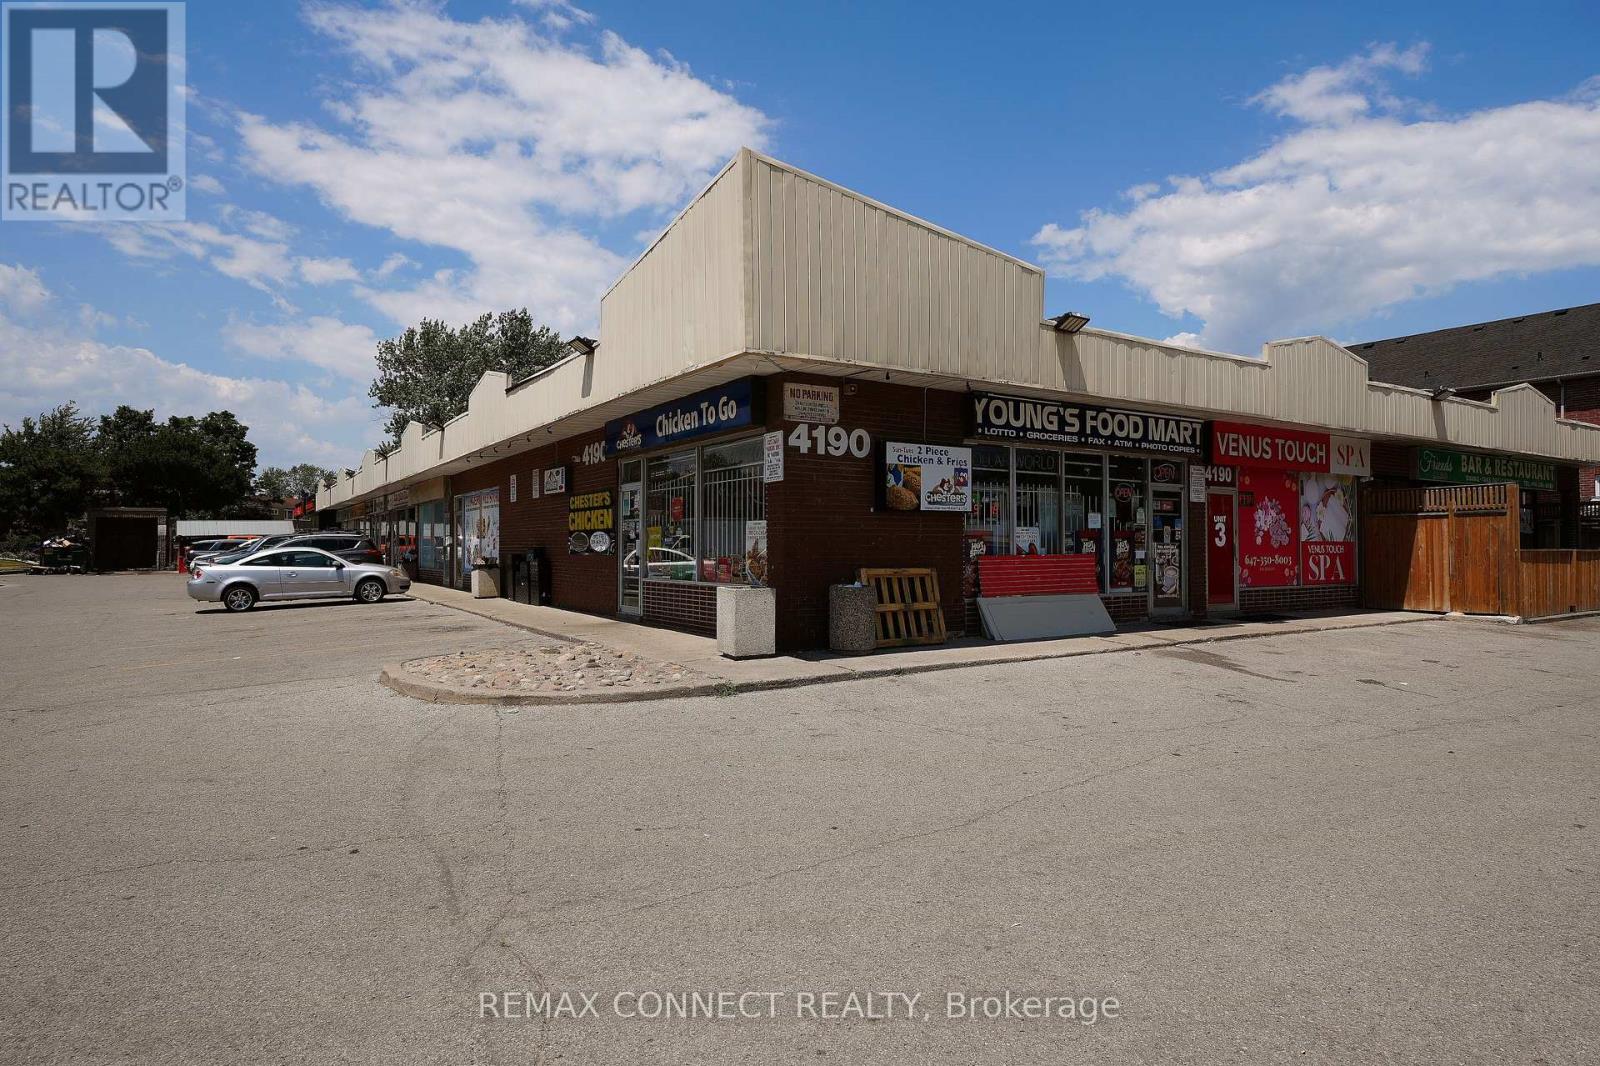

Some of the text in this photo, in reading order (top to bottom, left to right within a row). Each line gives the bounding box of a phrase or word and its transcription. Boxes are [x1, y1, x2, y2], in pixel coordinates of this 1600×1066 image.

[790, 388, 833, 402] NO PARKING
[656, 395, 737, 438] Chicken To Go
[974, 398, 1202, 446] YOUNG'S FOOD MART
[788, 423, 871, 459] 4190
[918, 446, 923, 455] 2
[926, 447, 949, 456] Piece
[984, 427, 1195, 454] LOTTO GROCERIES FAX ATM PHOTO COPIES
[1216, 431, 1366, 467] VENUS TOUCH SPA
[897, 454, 967, 467] Chicken & Fries
[1461, 454, 1482, 474] BAR
[1485, 458, 1492, 475] &
[1495, 458, 1554, 481] RESTAURANT
[1205, 465, 1232, 482] 4190
[569, 491, 611, 510] CHESTER'S
[568, 509, 613, 531] CHICKEN
[1213, 515, 1227, 523] UNIT
[1214, 522, 1227, 547] 3
[1308, 544, 1345, 554] VENUS TOUCH
[1308, 554, 1345, 581] SPA
